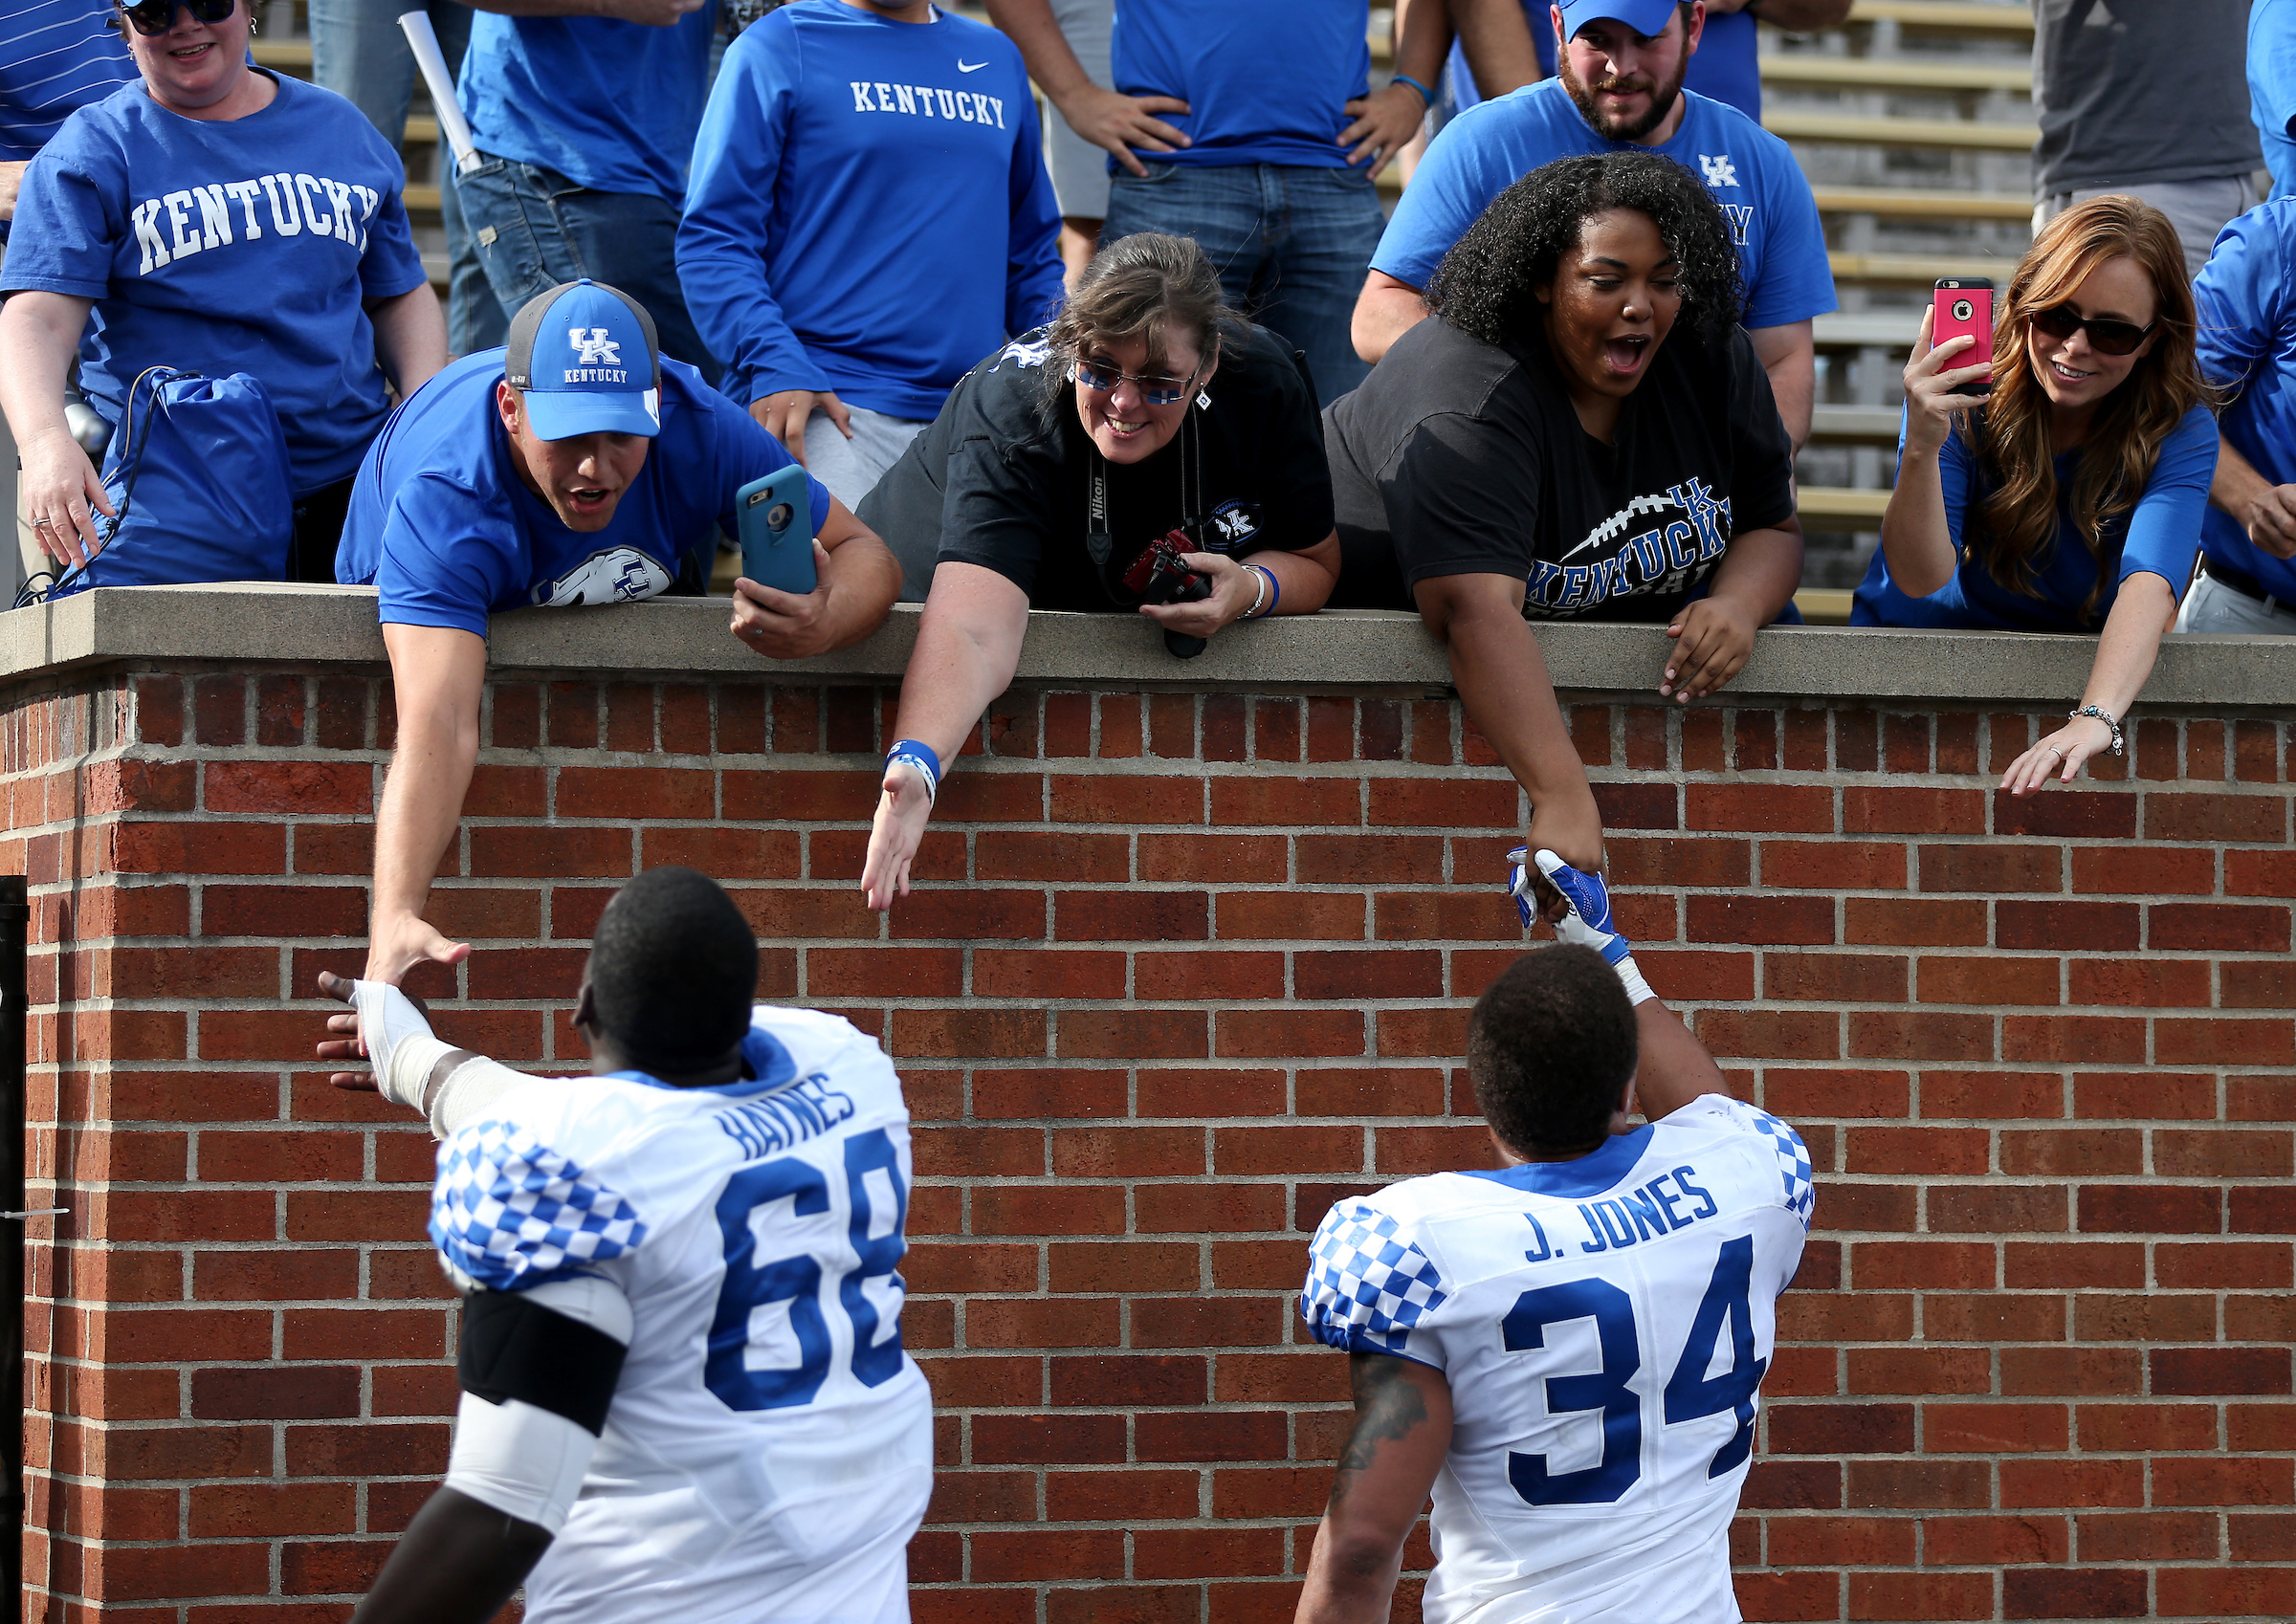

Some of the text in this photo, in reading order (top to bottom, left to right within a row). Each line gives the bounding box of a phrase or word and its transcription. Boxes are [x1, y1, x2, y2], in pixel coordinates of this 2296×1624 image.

[849, 81, 1006, 130] KENTUCKY
[1698, 154, 1740, 187] UK
[131, 172, 379, 276] KENTUCKY
[568, 328, 622, 366] UK
[564, 368, 628, 384] KENTUCKY
[1092, 476, 1105, 520] Nikon
[1666, 476, 1718, 520] UK
[713, 1071, 855, 1161] HAYNES
[1523, 1164, 1718, 1262] J. JONES
[703, 1126, 908, 1413] 68
[1498, 1233, 1768, 1507] 34
